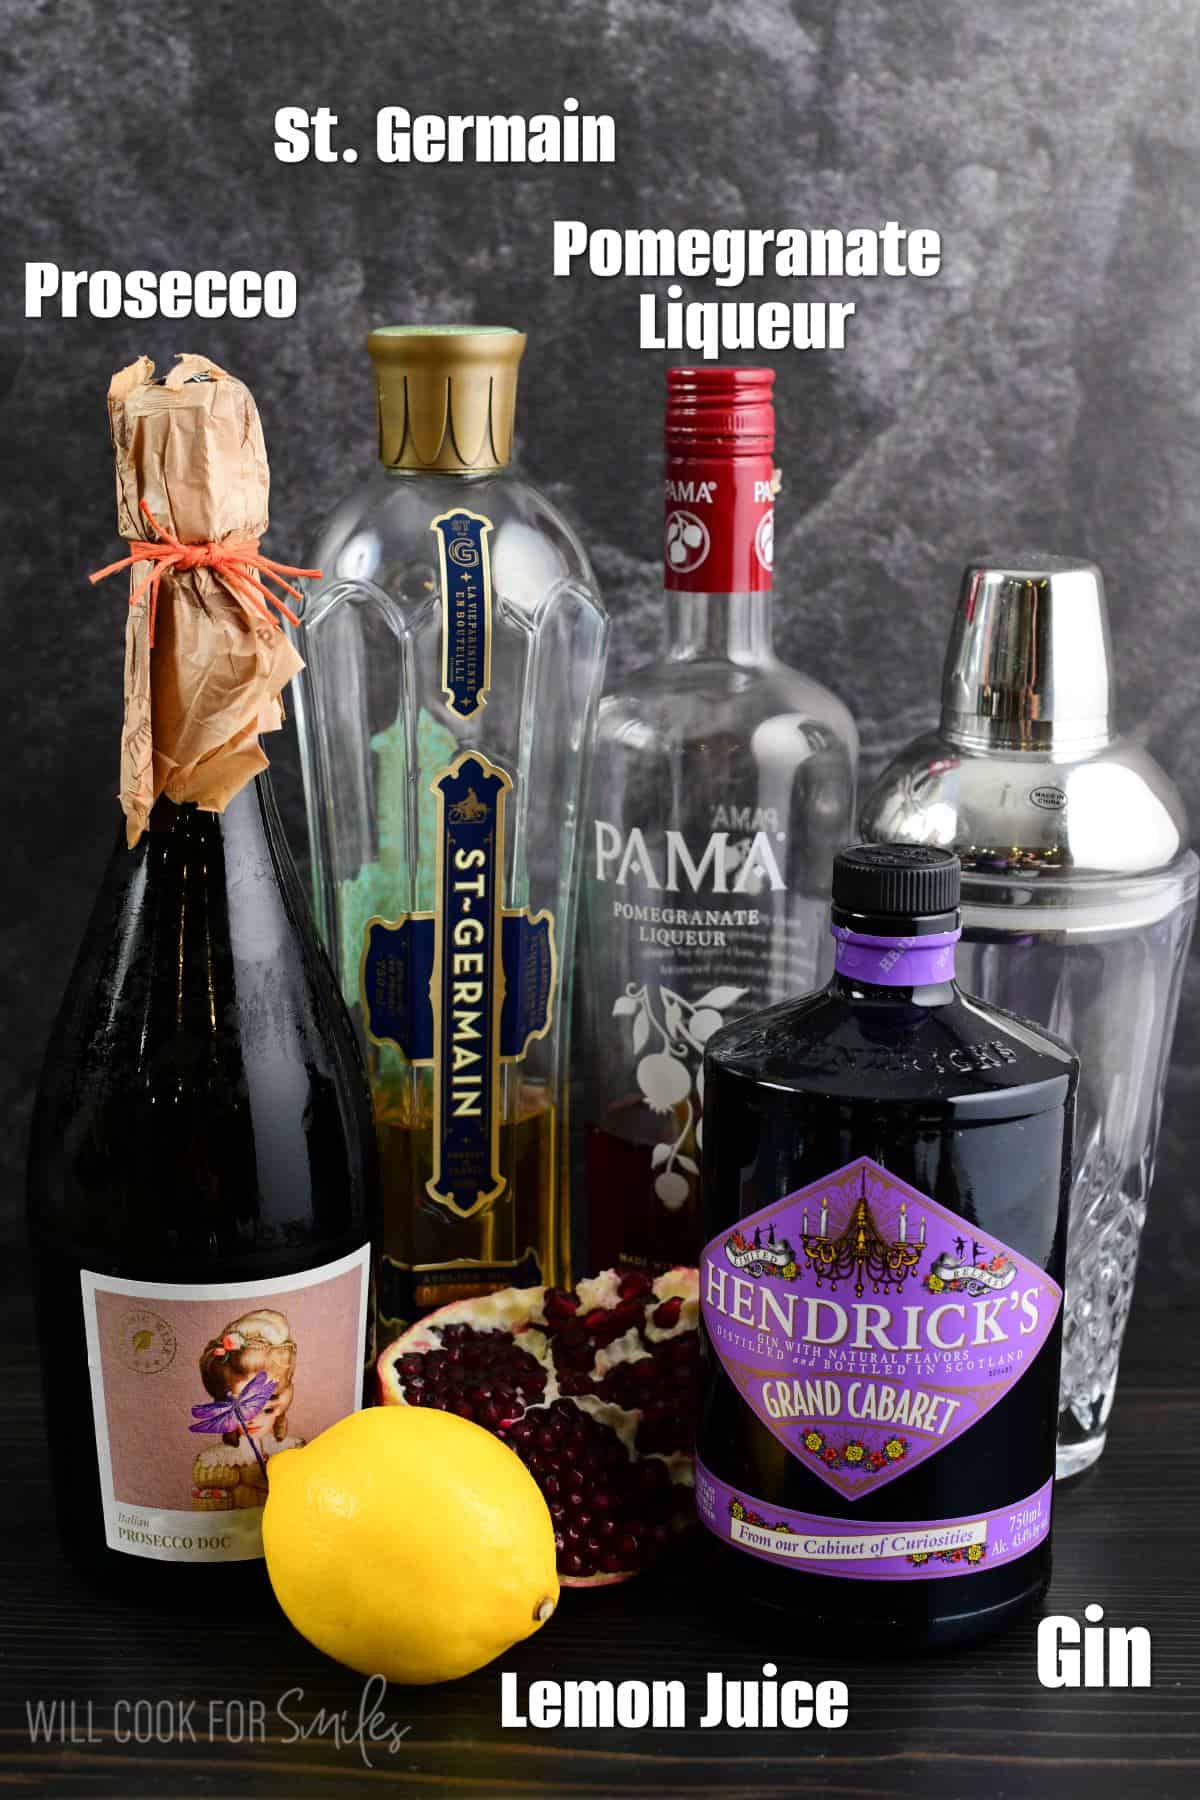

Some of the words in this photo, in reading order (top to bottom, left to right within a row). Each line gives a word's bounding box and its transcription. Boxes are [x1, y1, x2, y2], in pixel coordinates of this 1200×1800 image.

[613, 901, 760, 927] POMEGRANATE
[638, 926, 727, 948] LIQUEUR
[705, 1259, 1042, 1351] HENDRICK'S
[716, 1324, 785, 1361] DISTILLED
[824, 1359, 907, 1376] BOTTLED
[916, 1364, 937, 1376] IN
[945, 1350, 1024, 1374] SCOTLAND
[757, 1333, 780, 1348] GIN
[785, 1341, 822, 1356] WITH
[828, 1348, 898, 1365] NATURAL
[905, 1350, 969, 1365] FLAVORS
[762, 1379, 842, 1419] GRAND
[847, 1382, 961, 1435] CABARET
[117, 1511, 151, 1528] Italian
[118, 1527, 194, 1550] PROSECCO
[199, 1536, 233, 1550] DOC
[738, 1525, 772, 1548] From
[775, 1538, 799, 1552] our
[803, 1539, 865, 1555] Cabinet
[870, 1537, 889, 1557] of
[891, 1527, 974, 1552] Curiosities
